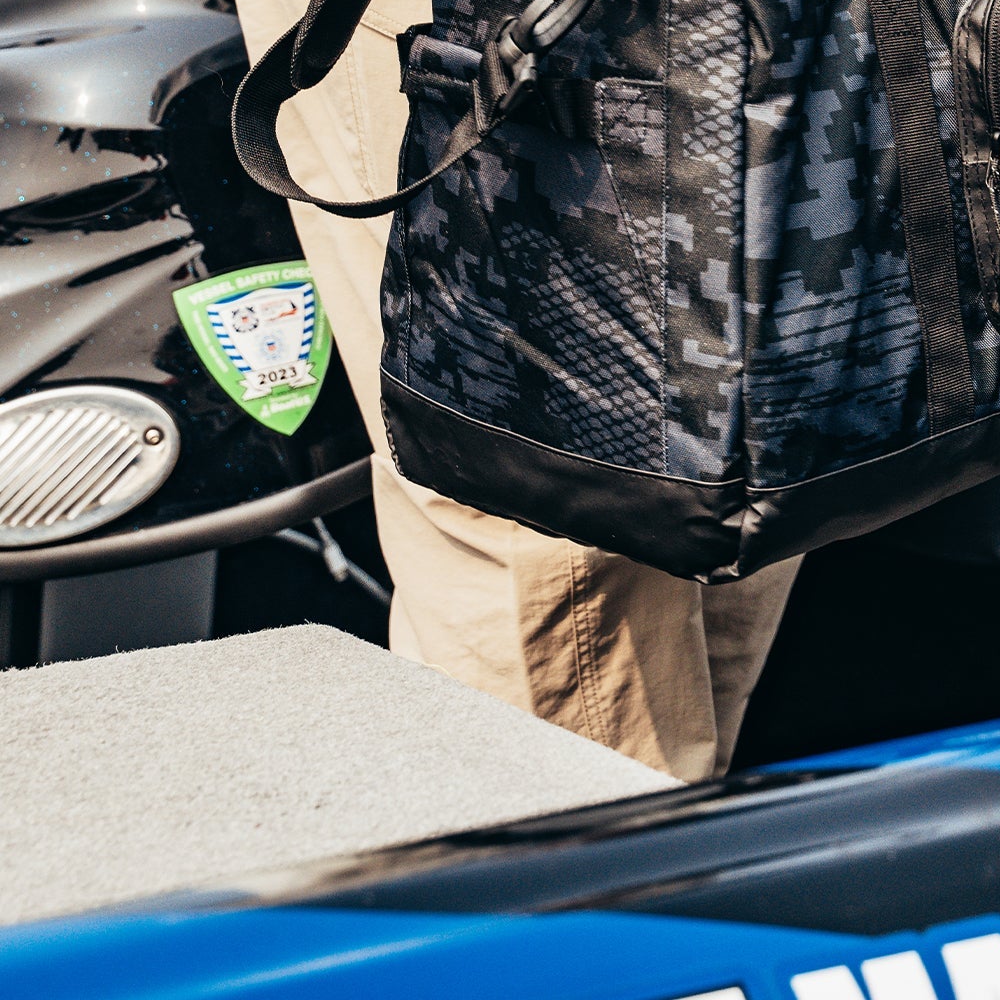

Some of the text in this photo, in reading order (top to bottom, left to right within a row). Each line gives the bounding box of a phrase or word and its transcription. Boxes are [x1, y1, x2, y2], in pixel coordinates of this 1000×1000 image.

[235, 268, 281, 289] SAFETY
[281, 266, 312, 281] CHEC
[257, 366, 298, 385] 2023
